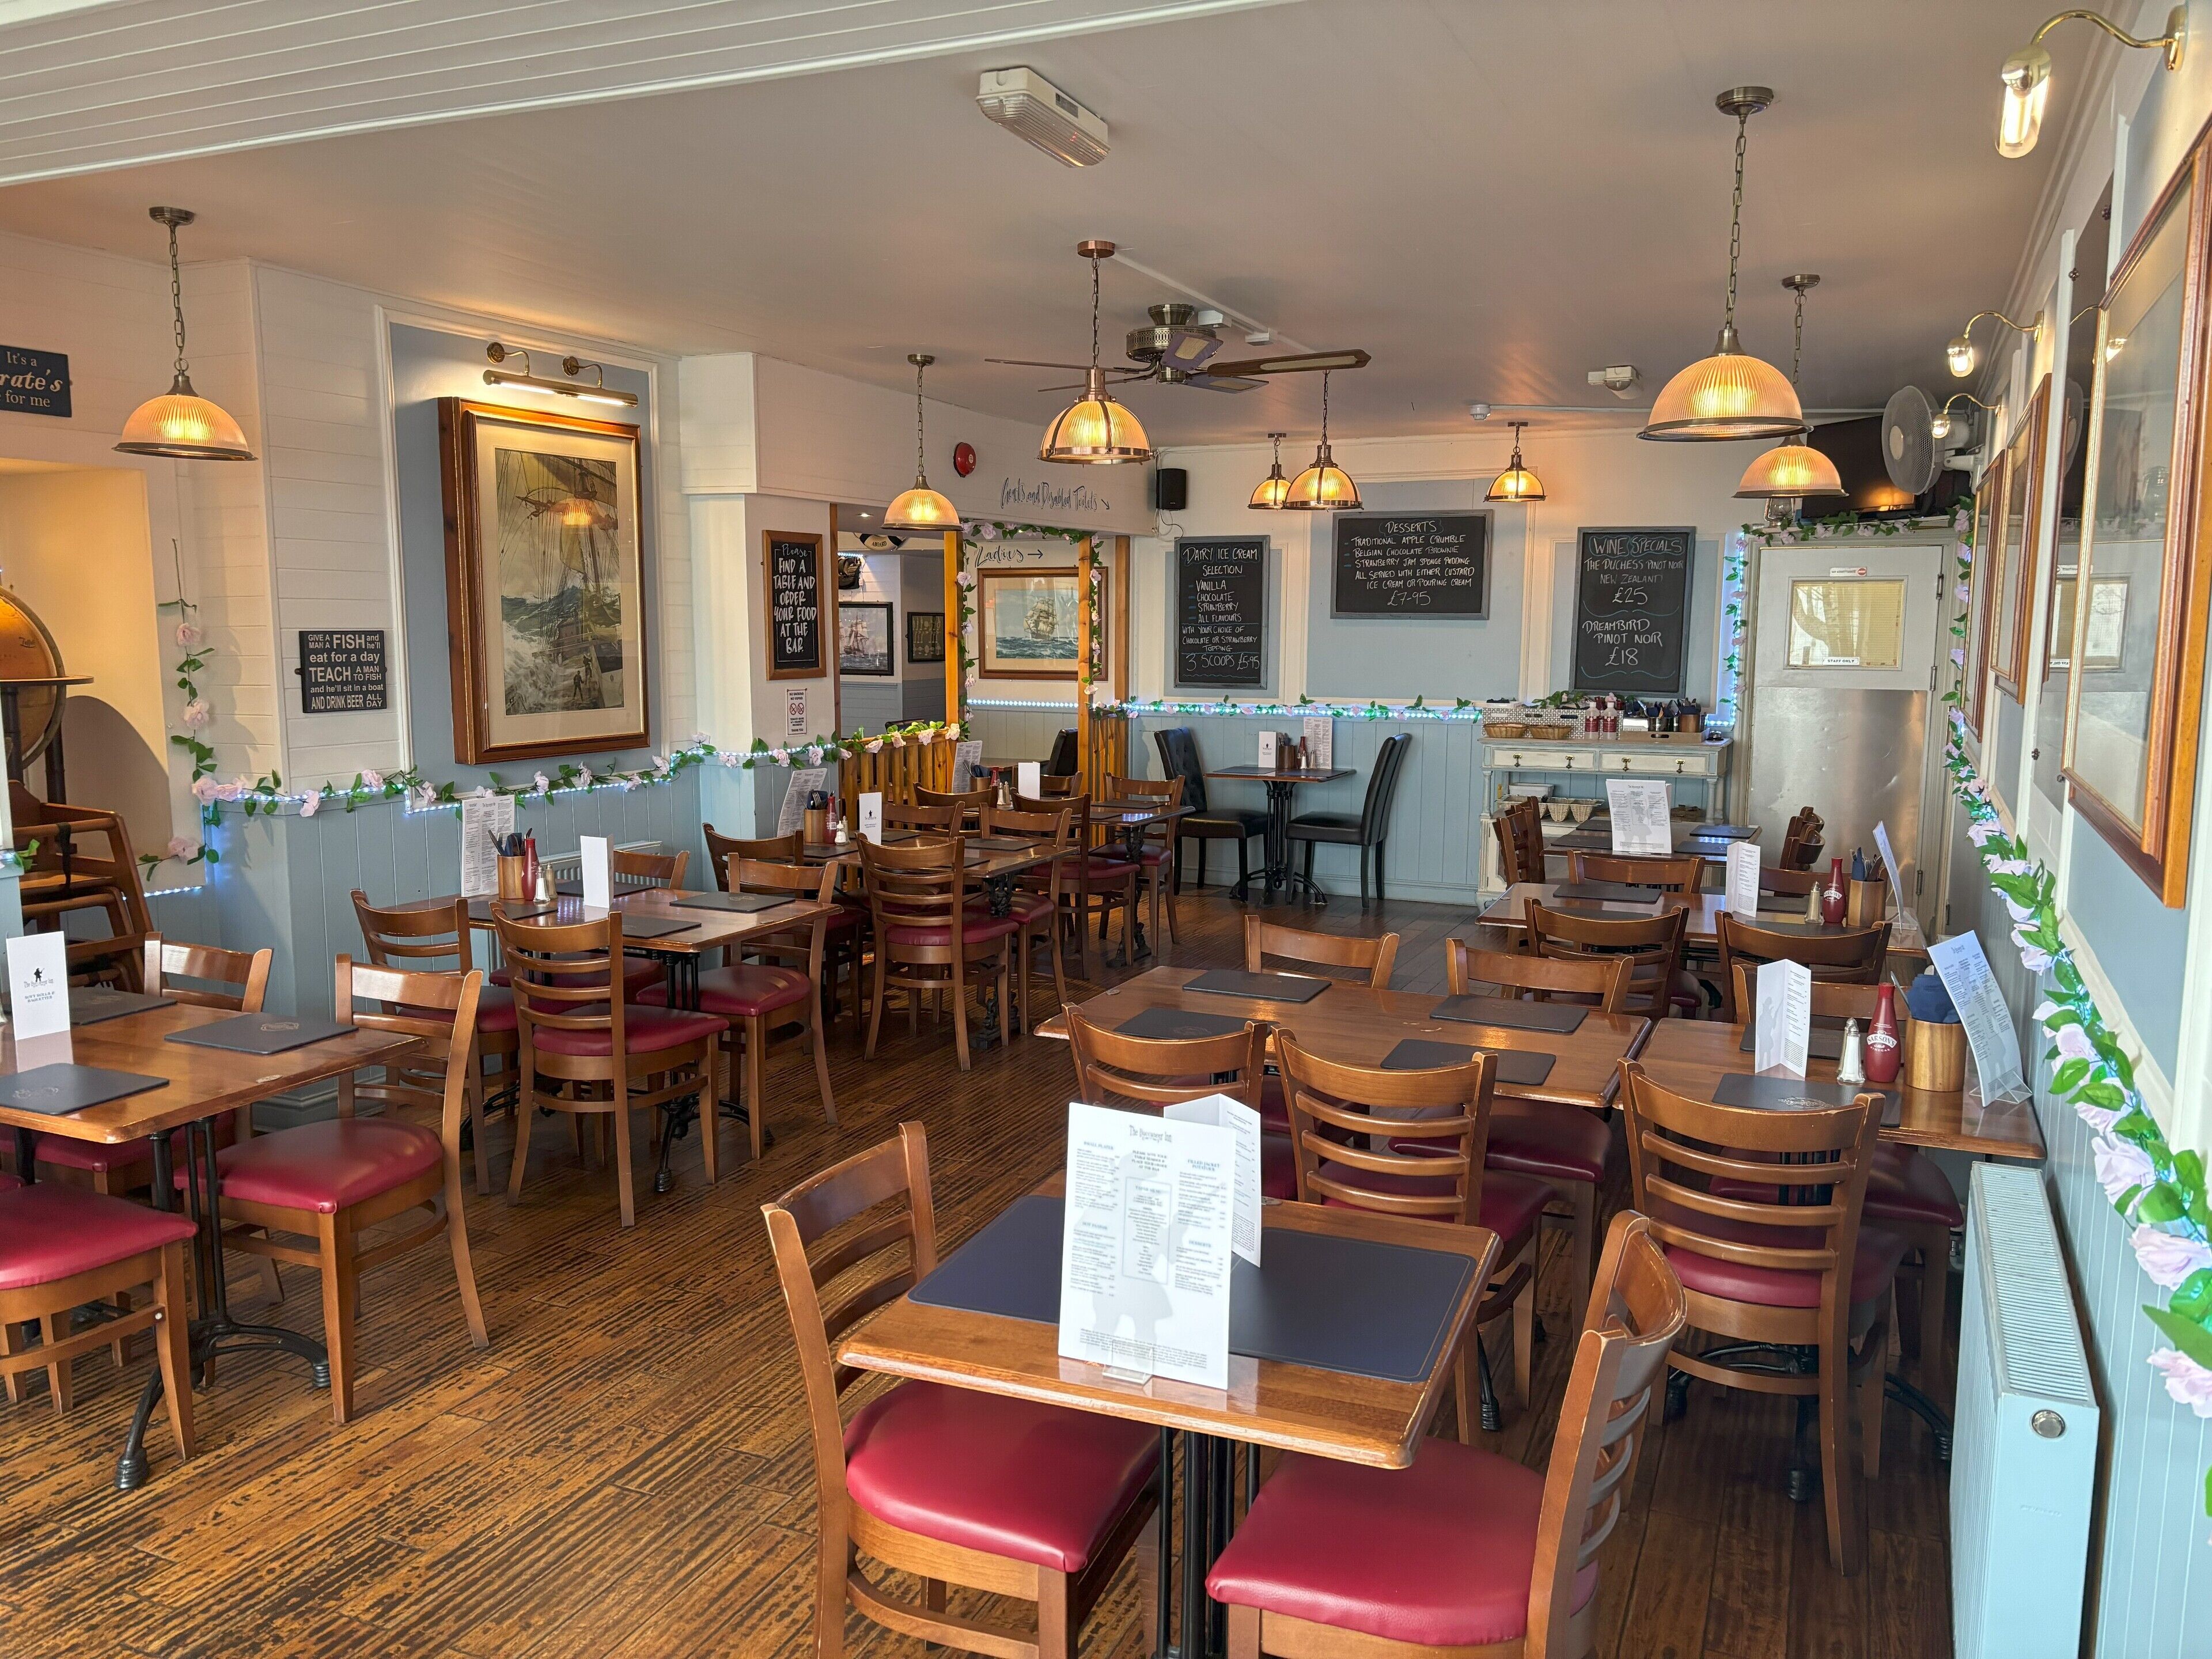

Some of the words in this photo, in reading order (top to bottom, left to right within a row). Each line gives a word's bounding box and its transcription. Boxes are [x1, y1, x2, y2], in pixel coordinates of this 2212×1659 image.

[6, 351, 26, 365] It's
[31, 358, 37, 366] a
[5, 390, 25, 404] for
[30, 396, 50, 407] me
[1027, 484, 1040, 505] and
[1041, 482, 1071, 509] Disabled
[1073, 486, 1097, 511] Toilets
[1385, 520, 1437, 533] DESSERTS
[1351, 536, 1396, 547] TRADITIONAL
[1402, 536, 1425, 544] APPLE
[1430, 535, 1466, 543] CRUMBLE
[1593, 537, 1627, 555] WINE
[1631, 537, 1682, 553] SPECIALS
[782, 543, 808, 557] Please
[974, 546, 1024, 568] Ladies
[1183, 547, 1213, 564] DAIRY
[1218, 548, 1229, 560] ICE
[1232, 548, 1257, 560] CREAM
[1353, 548, 1383, 558] BELGIAN
[1387, 547, 1423, 556] CHOCOLATE
[1425, 546, 1460, 554] BROWNIE
[779, 558, 796, 573] FIND
[799, 559, 806, 573] A
[1355, 558, 1400, 568] STRAWBERRY
[1403, 558, 1416, 566] JAM
[1419, 557, 1442, 566] SPONGE
[1444, 556, 1470, 565] PUDDING
[1584, 557, 1603, 571] THE
[1602, 558, 1643, 570] DUCHESS
[1646, 559, 1666, 570] PINOT
[1668, 560, 1683, 569] NOIR
[1202, 565, 1243, 576] SELECTION
[1355, 571, 1367, 580] ALL
[1369, 570, 1395, 579] SERVED
[1398, 569, 1412, 577] WITH
[1416, 568, 1441, 577] EITHER
[1444, 567, 1475, 577] CUSTARD
[773, 575, 796, 589] TABLE
[798, 576, 815, 589] AND
[1196, 579, 1226, 592] VANILLA
[1367, 581, 1378, 589] ICE
[1382, 579, 1403, 589] CREAM
[1407, 579, 1415, 588] OR
[1417, 578, 1447, 588] POURING
[1450, 578, 1472, 587] CREAM
[1600, 574, 1616, 585] NEW
[1620, 573, 1663, 584] ZEALAND
[780, 590, 806, 605] ORDER
[1197, 591, 1234, 602] CHOCOLATE
[1612, 586, 1647, 605] £25
[774, 606, 794, 622] YOUR
[797, 607, 817, 622] FOOD
[1198, 602, 1238, 612] STRAWBERRY
[1198, 614, 1209, 624] ALL
[1212, 613, 1242, 622] FLAVOURS
[781, 623, 791, 637] AT
[793, 622, 808, 636] THE
[1182, 626, 1195, 634] WITH
[1198, 626, 1212, 634] YOUR
[1582, 619, 1650, 634] DREAMBIRD
[333, 634, 365, 649] FISH
[786, 637, 804, 654] BAR.
[1182, 637, 1209, 645] CHOCOLATE
[1593, 632, 1628, 644] PINOT
[1634, 631, 1663, 647] NOIR
[310, 652, 328, 662] eat
[331, 652, 347, 662] for
[361, 652, 380, 664] day
[1185, 653, 1196, 671] 3
[1200, 654, 1234, 668] SCOOPS
[1605, 646, 1638, 666] £18
[309, 666, 351, 682] TEACH
[312, 696, 325, 710] AND
[327, 695, 346, 709] DRINK
[347, 695, 363, 707] BEER
[1868, 1035, 1895, 1046] SARSON'S
